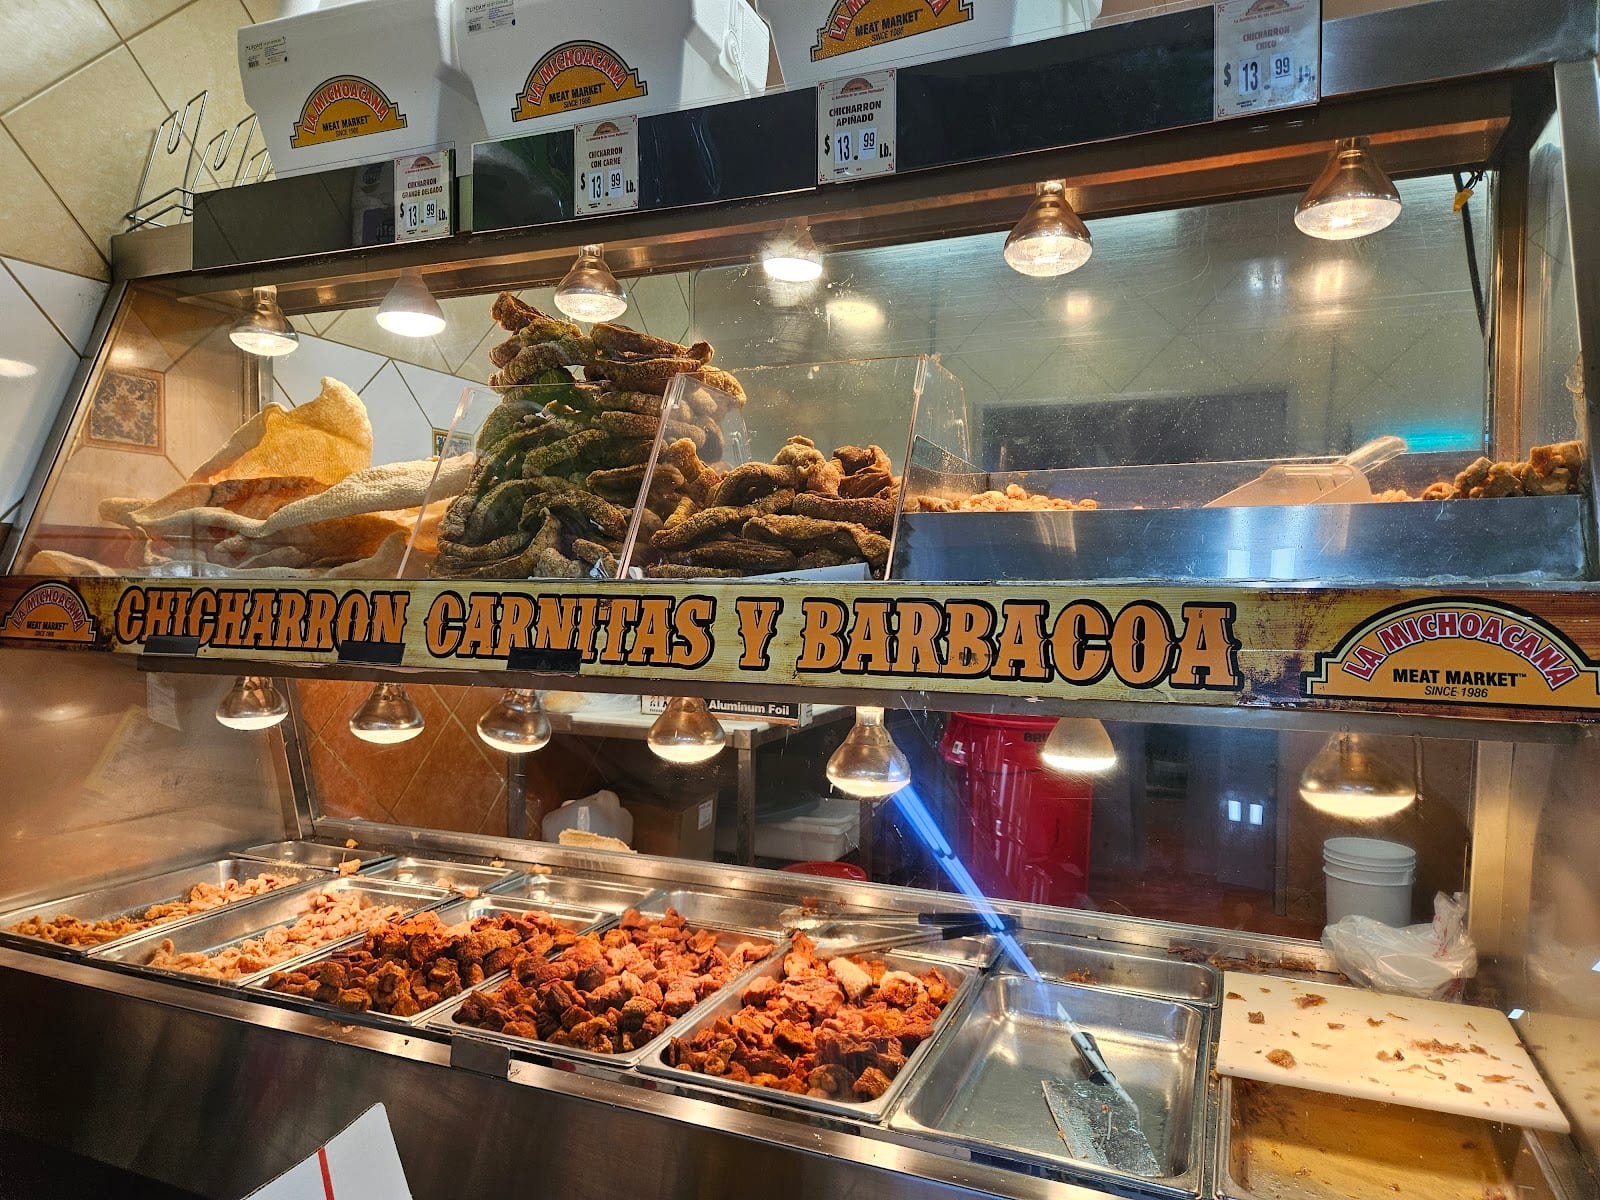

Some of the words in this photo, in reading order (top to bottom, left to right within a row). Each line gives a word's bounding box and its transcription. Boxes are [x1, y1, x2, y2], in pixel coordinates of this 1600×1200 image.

[829, 14, 851, 41] LA
[855, 21, 879, 37] MEAT
[881, 10, 920, 30] MARKET
[1243, 25, 1290, 42] CHICHARRON
[1256, 40, 1277, 51] CHICO
[527, 82, 546, 106] LA
[539, 47, 628, 91] MICHOACANA
[549, 92, 569, 103] MEAT
[571, 84, 603, 98] MARKET
[302, 112, 320, 135] LA
[313, 80, 390, 122] MICHOACANA
[829, 100, 882, 117] CHICHARRON
[322, 122, 340, 132] MEAT
[341, 115, 369, 127] MARKET
[836, 113, 874, 127] APIÑADO
[588, 147, 623, 159] CHICHARRON
[590, 159, 602, 168] CON
[603, 157, 621, 167] CARNE
[407, 177, 437, 189] CHICHARRON
[26, 588, 86, 632] MICHOACANA
[114, 586, 411, 651] CHICHARRON
[424, 590, 717, 670] CARNITAS
[735, 595, 784, 671] Y
[797, 596, 1243, 692] BARBACOA
[1341, 645, 1388, 682] LA
[1376, 611, 1580, 691] MICHOACANA
[1393, 668, 1440, 684] MEAT
[1424, 685, 1458, 697] SINCE
[1460, 687, 1489, 698] 1986
[708, 699, 766, 714] Aluminum
[768, 704, 790, 716] Foil
